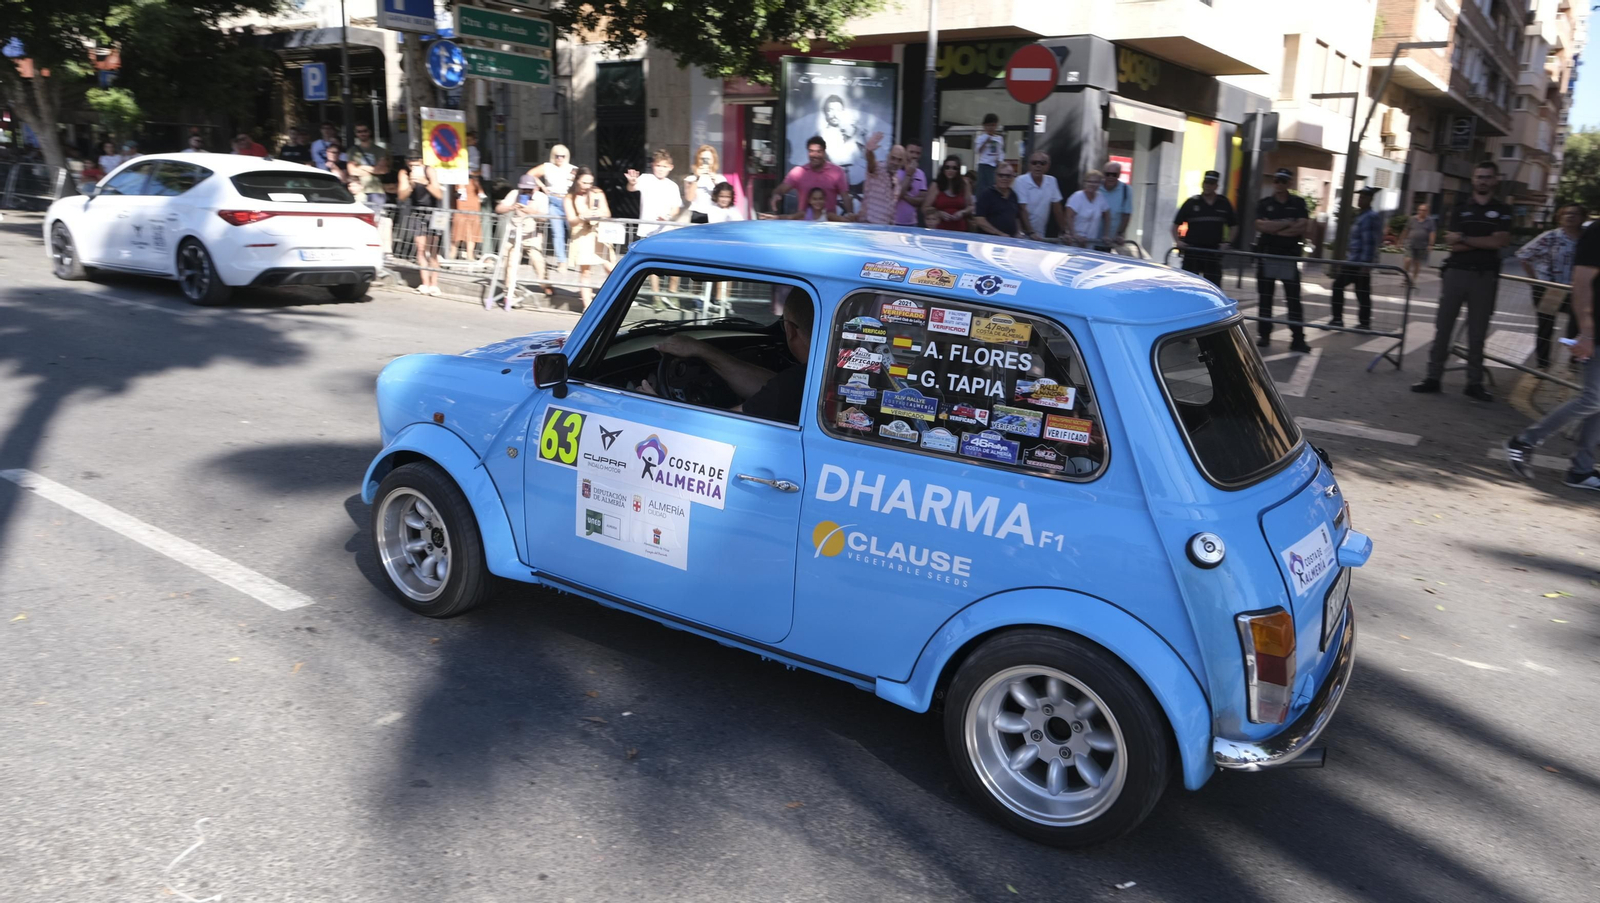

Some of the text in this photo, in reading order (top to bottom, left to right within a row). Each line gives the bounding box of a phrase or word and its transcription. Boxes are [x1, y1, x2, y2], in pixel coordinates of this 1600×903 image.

[487, 21, 499, 31] de
[309, 67, 322, 96] P
[864, 266, 905, 275] VERIFICADO
[917, 278, 946, 287] VERIFICADO
[882, 309, 925, 319] VERIFICADO
[862, 327, 887, 335] VERIFICADO
[933, 324, 966, 333] VERIFICADO
[984, 322, 1016, 334] 47 Rallye
[841, 356, 880, 366] VERIFICADO
[923, 341, 1033, 372] A. FLORES
[920, 370, 1005, 399] G. TAPIA
[906, 395, 926, 404] RALLYE
[1027, 398, 1059, 407] VERIFICADO
[890, 409, 925, 419] VERIFICADO
[949, 415, 977, 425] VERIFICADO
[991, 421, 1028, 433] VERIFICADO
[540, 409, 583, 464] 63
[1047, 429, 1088, 443] VERIFICADO
[965, 445, 982, 453] COSTA
[990, 448, 1012, 458] ALMERÍA
[970, 438, 1009, 452] 46 Rallye
[583, 453, 627, 468] CUPRA
[587, 461, 621, 474] INDALO MOTOR
[668, 456, 725, 480] COSTA DE
[655, 469, 722, 500] ALMERÍA
[593, 487, 627, 502] DIPUTACIÓN
[593, 494, 626, 509] DE ALMERÍA
[648, 500, 685, 517] ALMERÍA
[648, 509, 667, 519] CIUDAD
[815, 463, 1065, 552] DHARMA F1
[847, 531, 973, 578] CLAUSE
[1304, 551, 1318, 567] COSTA
[1316, 547, 1323, 558] DE
[847, 552, 968, 588] VEGETABLE SEEDS
[1304, 558, 1327, 586] ALMERÍA
